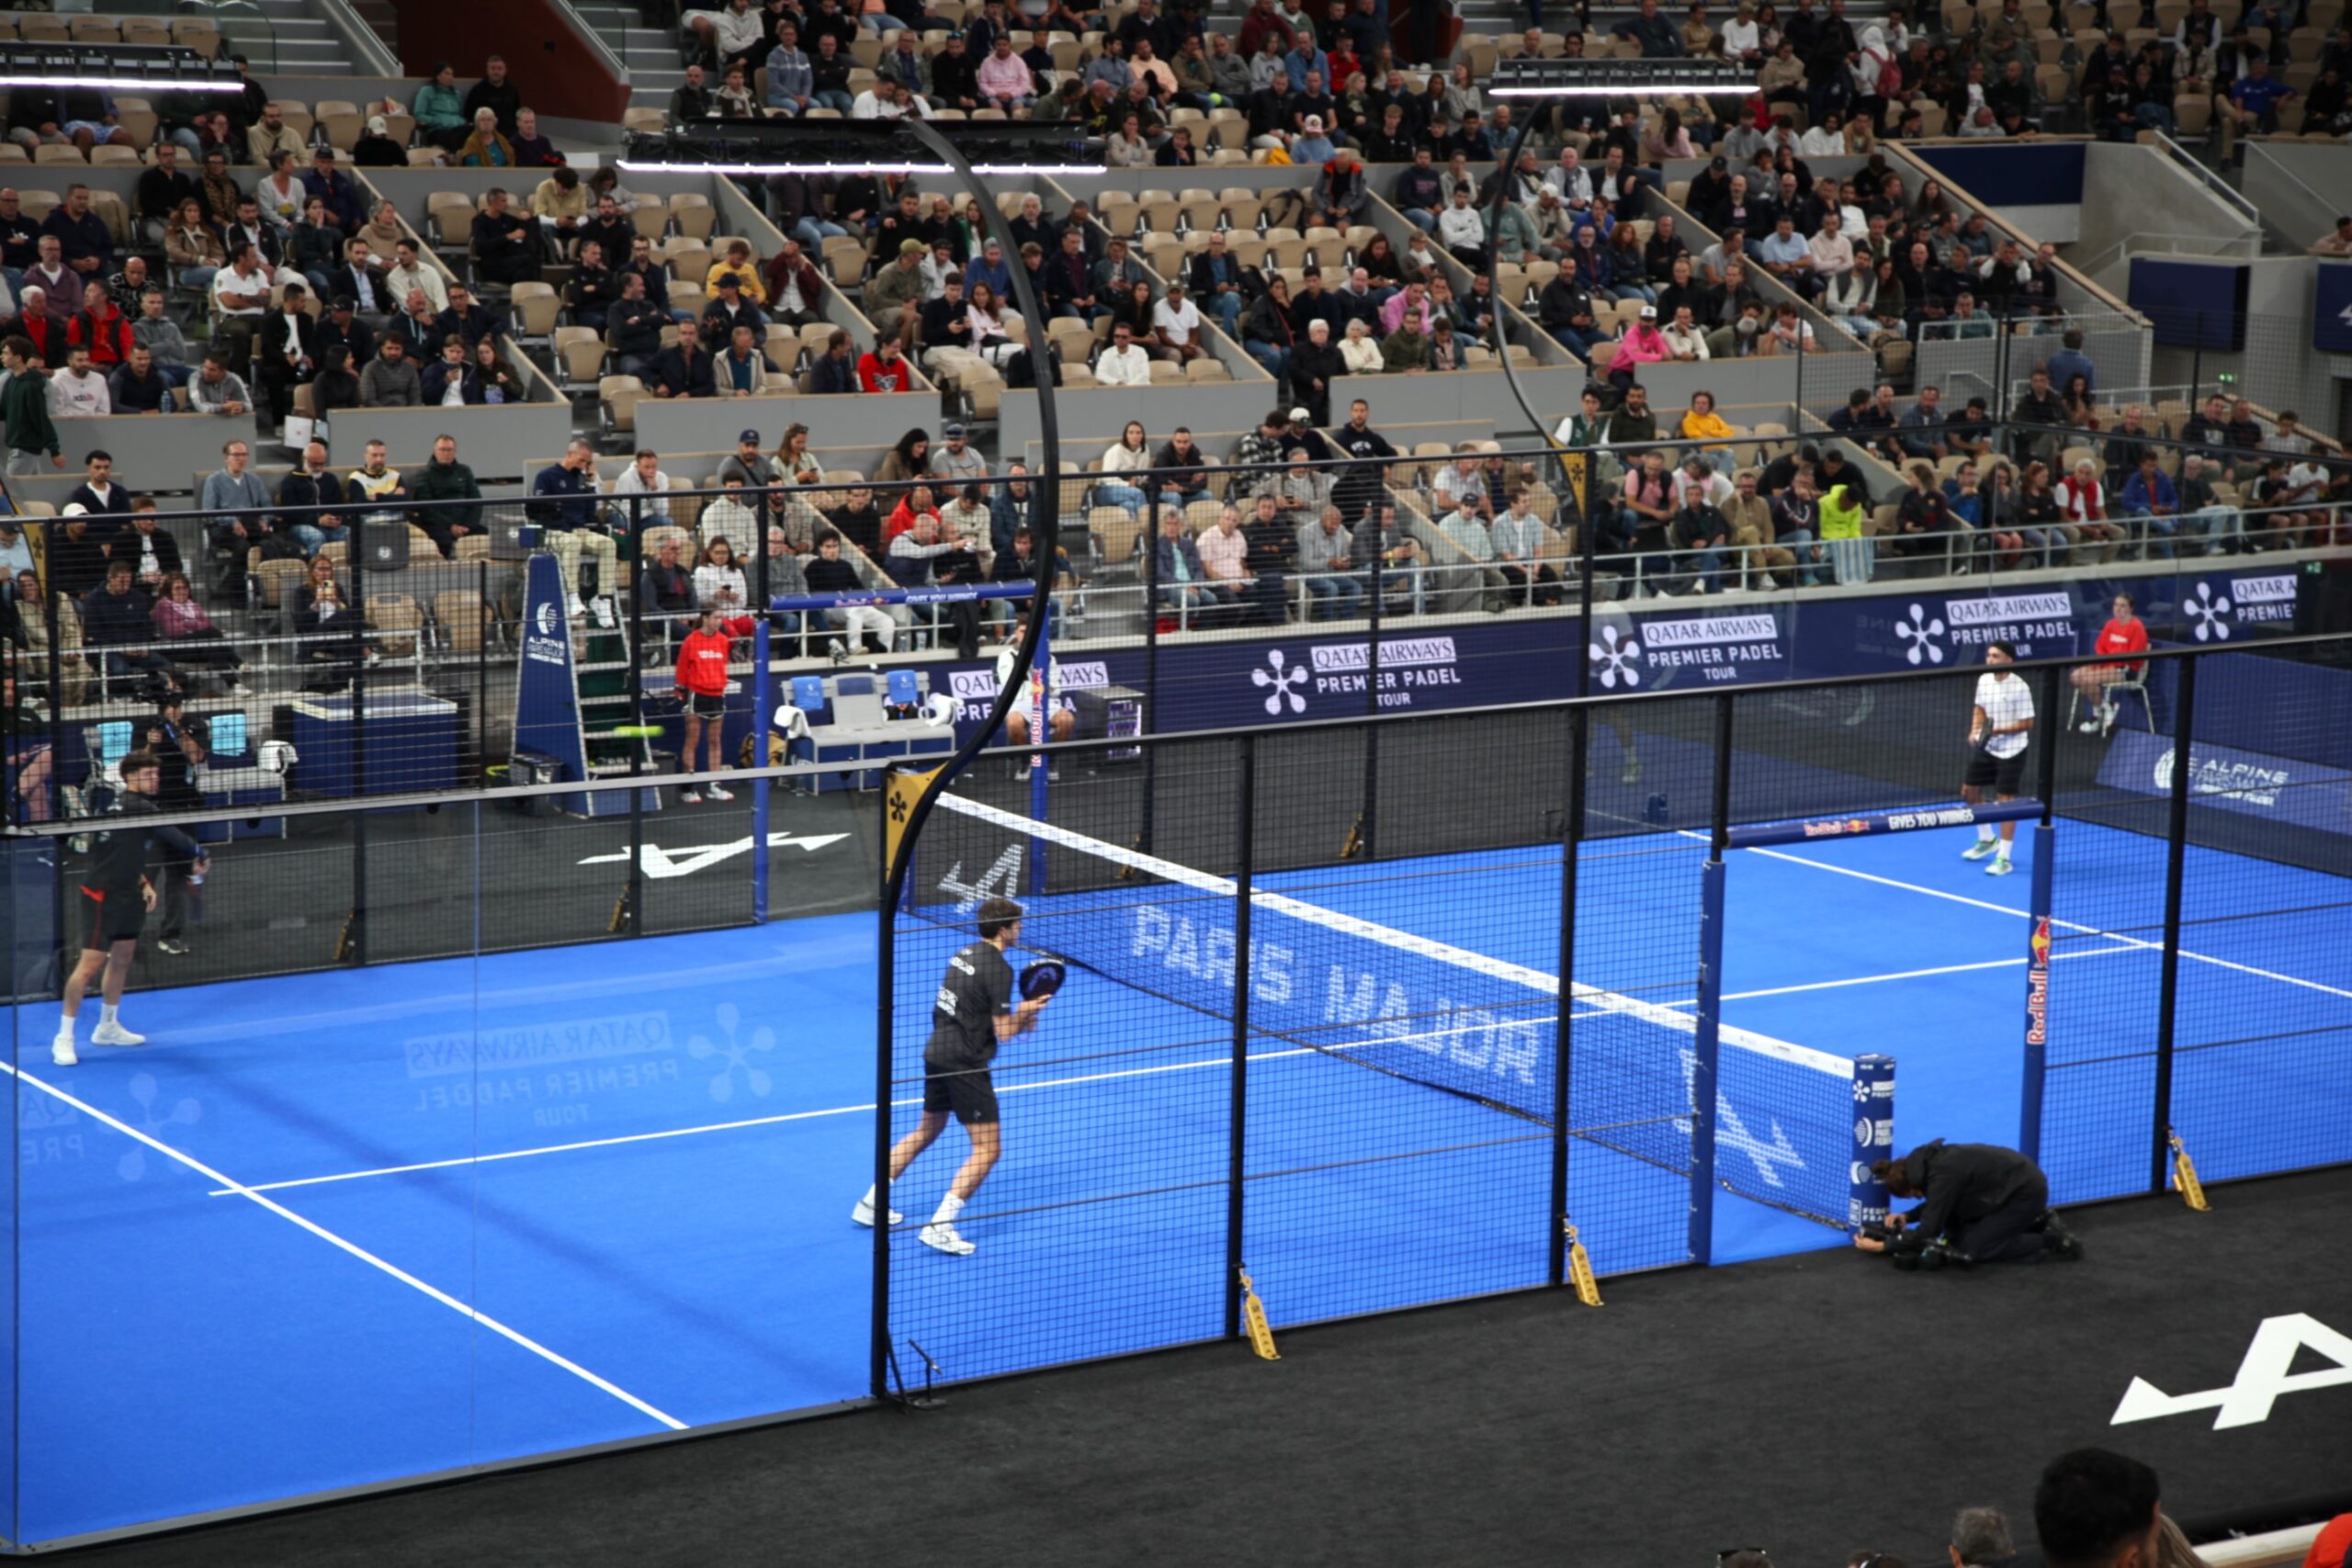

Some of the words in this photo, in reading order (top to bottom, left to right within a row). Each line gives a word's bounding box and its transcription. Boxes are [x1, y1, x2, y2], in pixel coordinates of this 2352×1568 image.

[2235, 578, 2285, 600] QATAR
[1950, 600, 2002, 623] QATAR
[2004, 595, 2068, 615] AIRWAYS
[2236, 604, 2296, 622] PREMIE
[1645, 625, 1702, 645] QATAR
[1704, 617, 1774, 639] AIRWAYS
[1951, 626, 2019, 645] PREMIER
[2024, 621, 2075, 639] PADEL
[1377, 641, 1453, 661] AIRWAYS
[1647, 647, 1724, 668] PREMIER
[1728, 643, 1783, 661] PADEL
[2015, 644, 2032, 657] UR
[1316, 672, 1396, 694] PREMER
[1402, 668, 1462, 687] PADEL
[1702, 666, 1737, 681] TOUR
[1375, 692, 1411, 706] TOUR
[2203, 759, 2289, 784] ALPINE
[1888, 815, 1916, 829] GIVES
[1916, 813, 1937, 828] YOU
[1938, 809, 1974, 825] WINGS
[1324, 964, 1539, 1084] MAJOR
